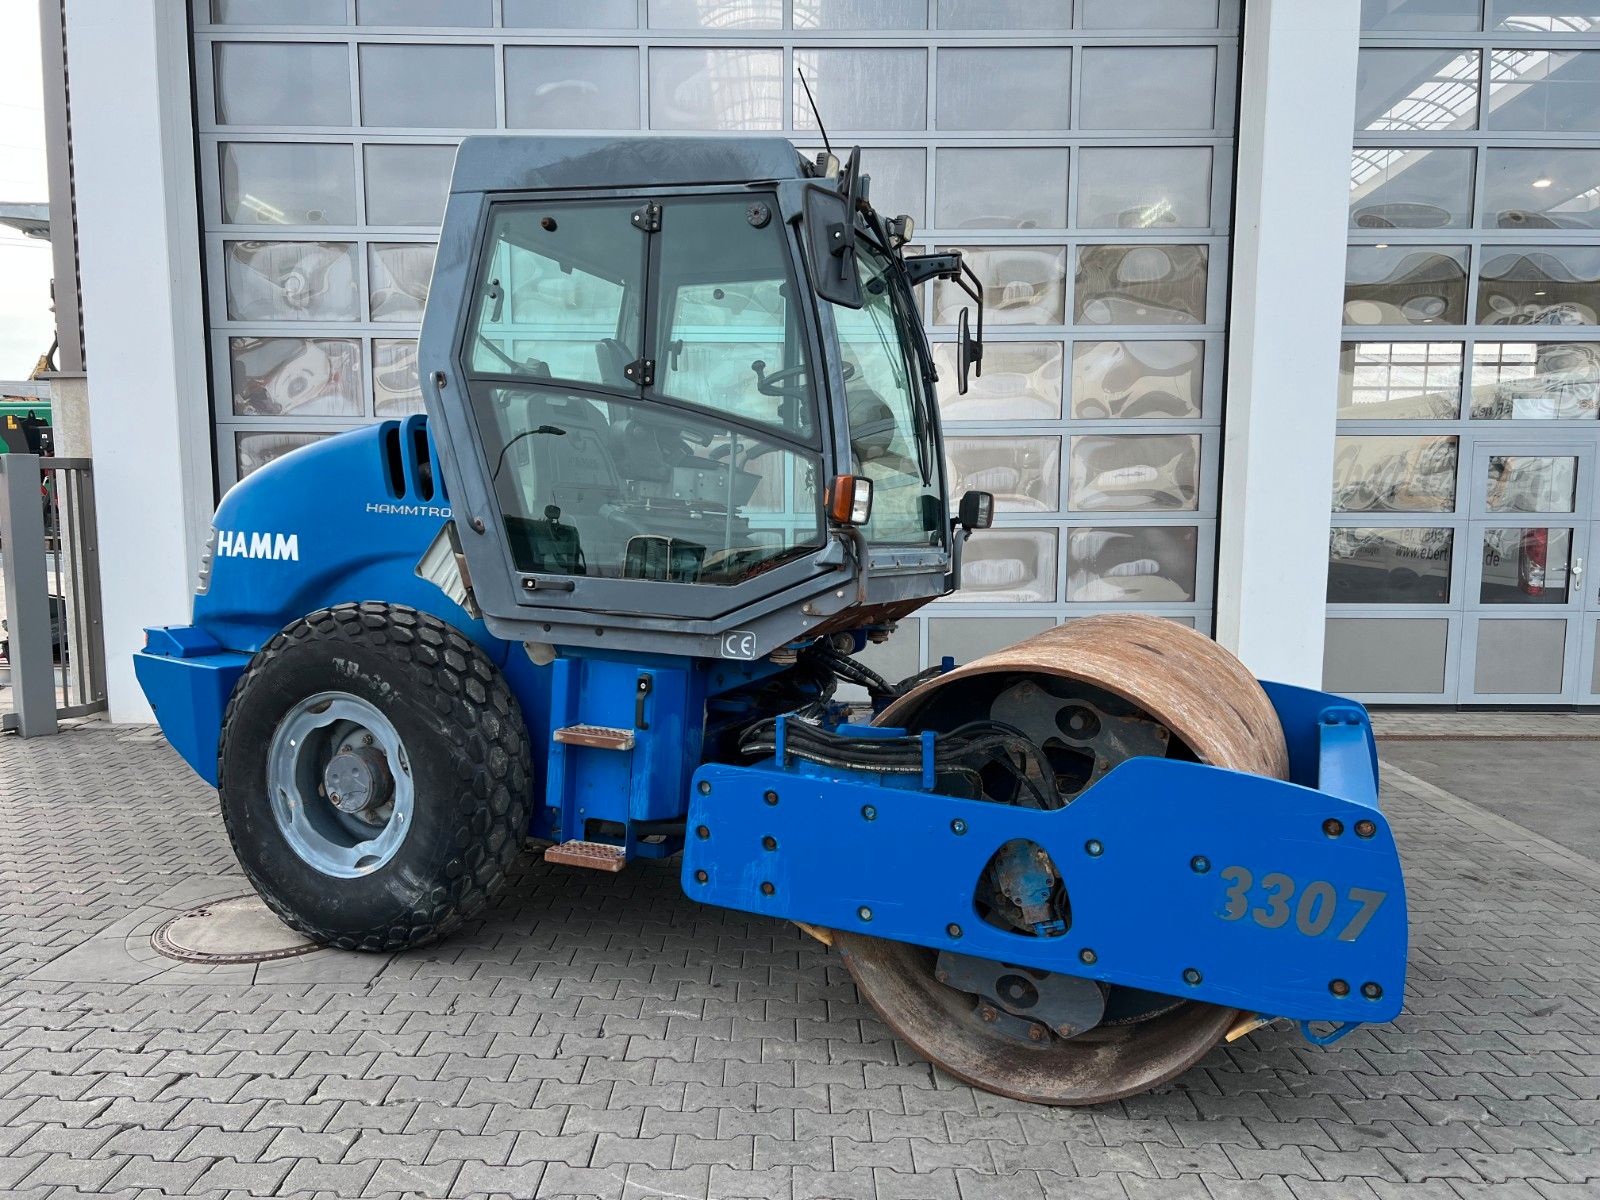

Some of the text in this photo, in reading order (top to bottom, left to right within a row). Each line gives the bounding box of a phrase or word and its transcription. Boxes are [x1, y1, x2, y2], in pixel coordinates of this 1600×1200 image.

[366, 502, 455, 518] HAMMTRO
[217, 530, 300, 562] HAMM
[725, 634, 753, 656] CE
[1218, 865, 1388, 943] 3307
